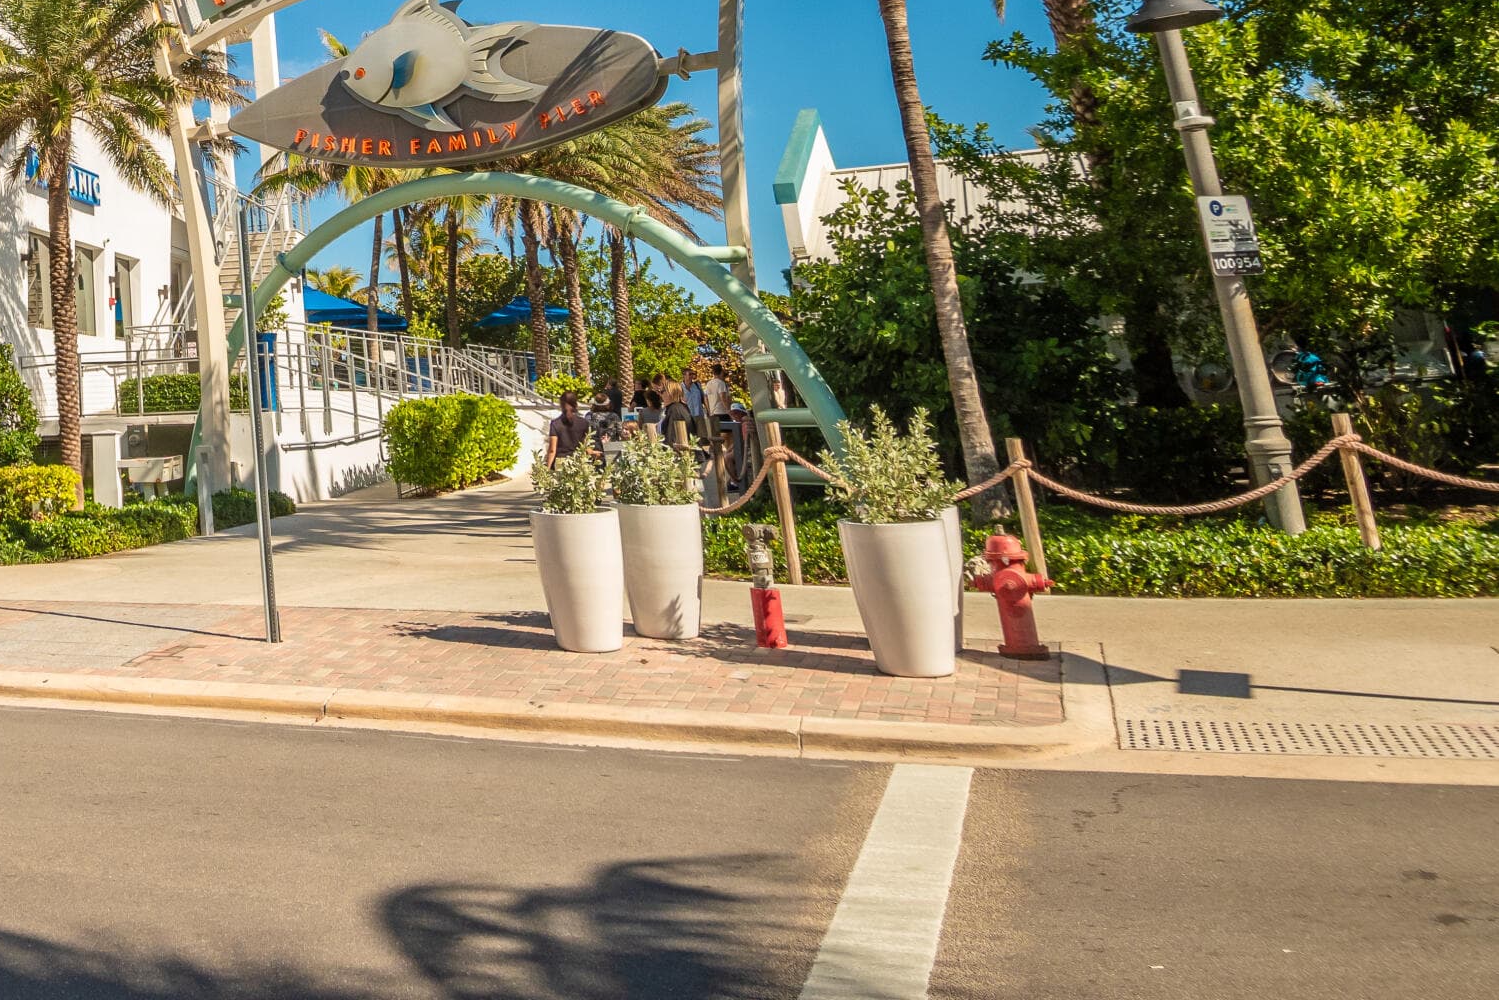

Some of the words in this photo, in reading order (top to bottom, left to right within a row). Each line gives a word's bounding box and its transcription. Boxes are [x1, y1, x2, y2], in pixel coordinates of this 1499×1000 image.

[294, 128, 392, 156] FISHER
[410, 121, 517, 155] FAMILY
[538, 90, 606, 129] PIER
[1214, 256, 1261, 270] 100954
